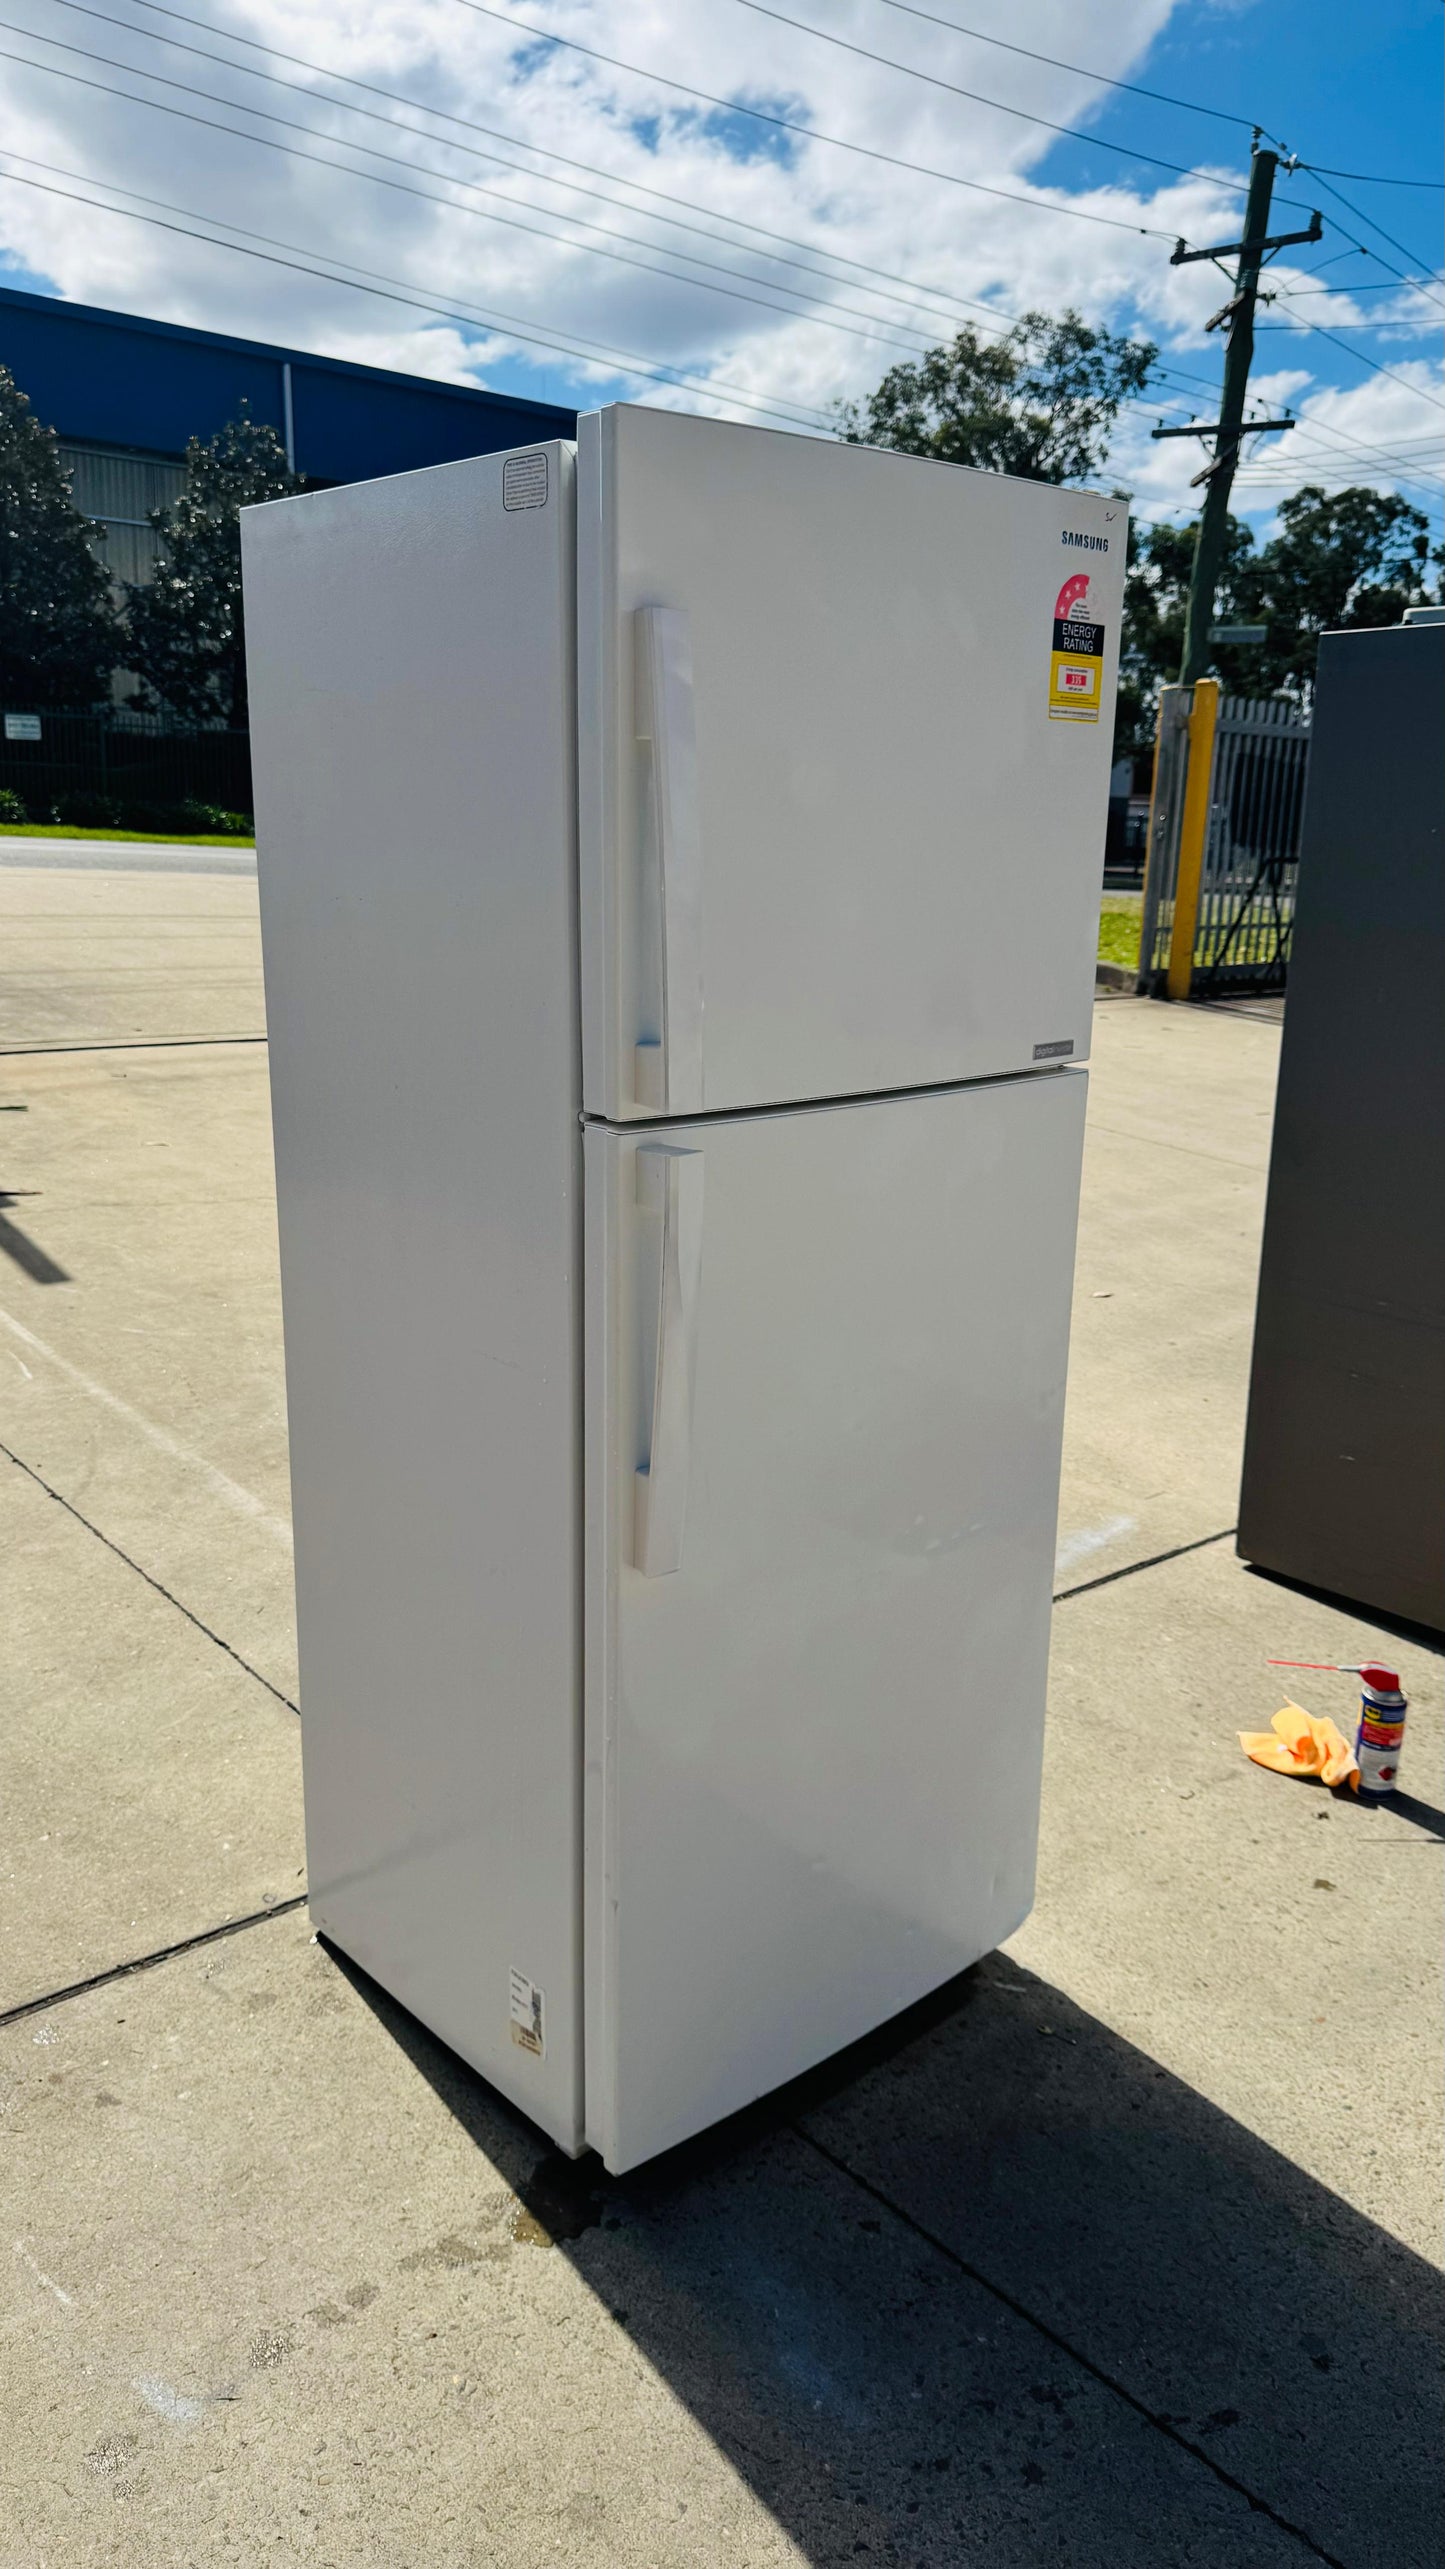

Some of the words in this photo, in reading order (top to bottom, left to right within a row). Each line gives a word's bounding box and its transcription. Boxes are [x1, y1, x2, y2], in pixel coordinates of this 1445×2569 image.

[1061, 530, 1109, 552] SAMSUNG
[1062, 623, 1097, 639] ENERGY
[1063, 637, 1094, 653] RATING
